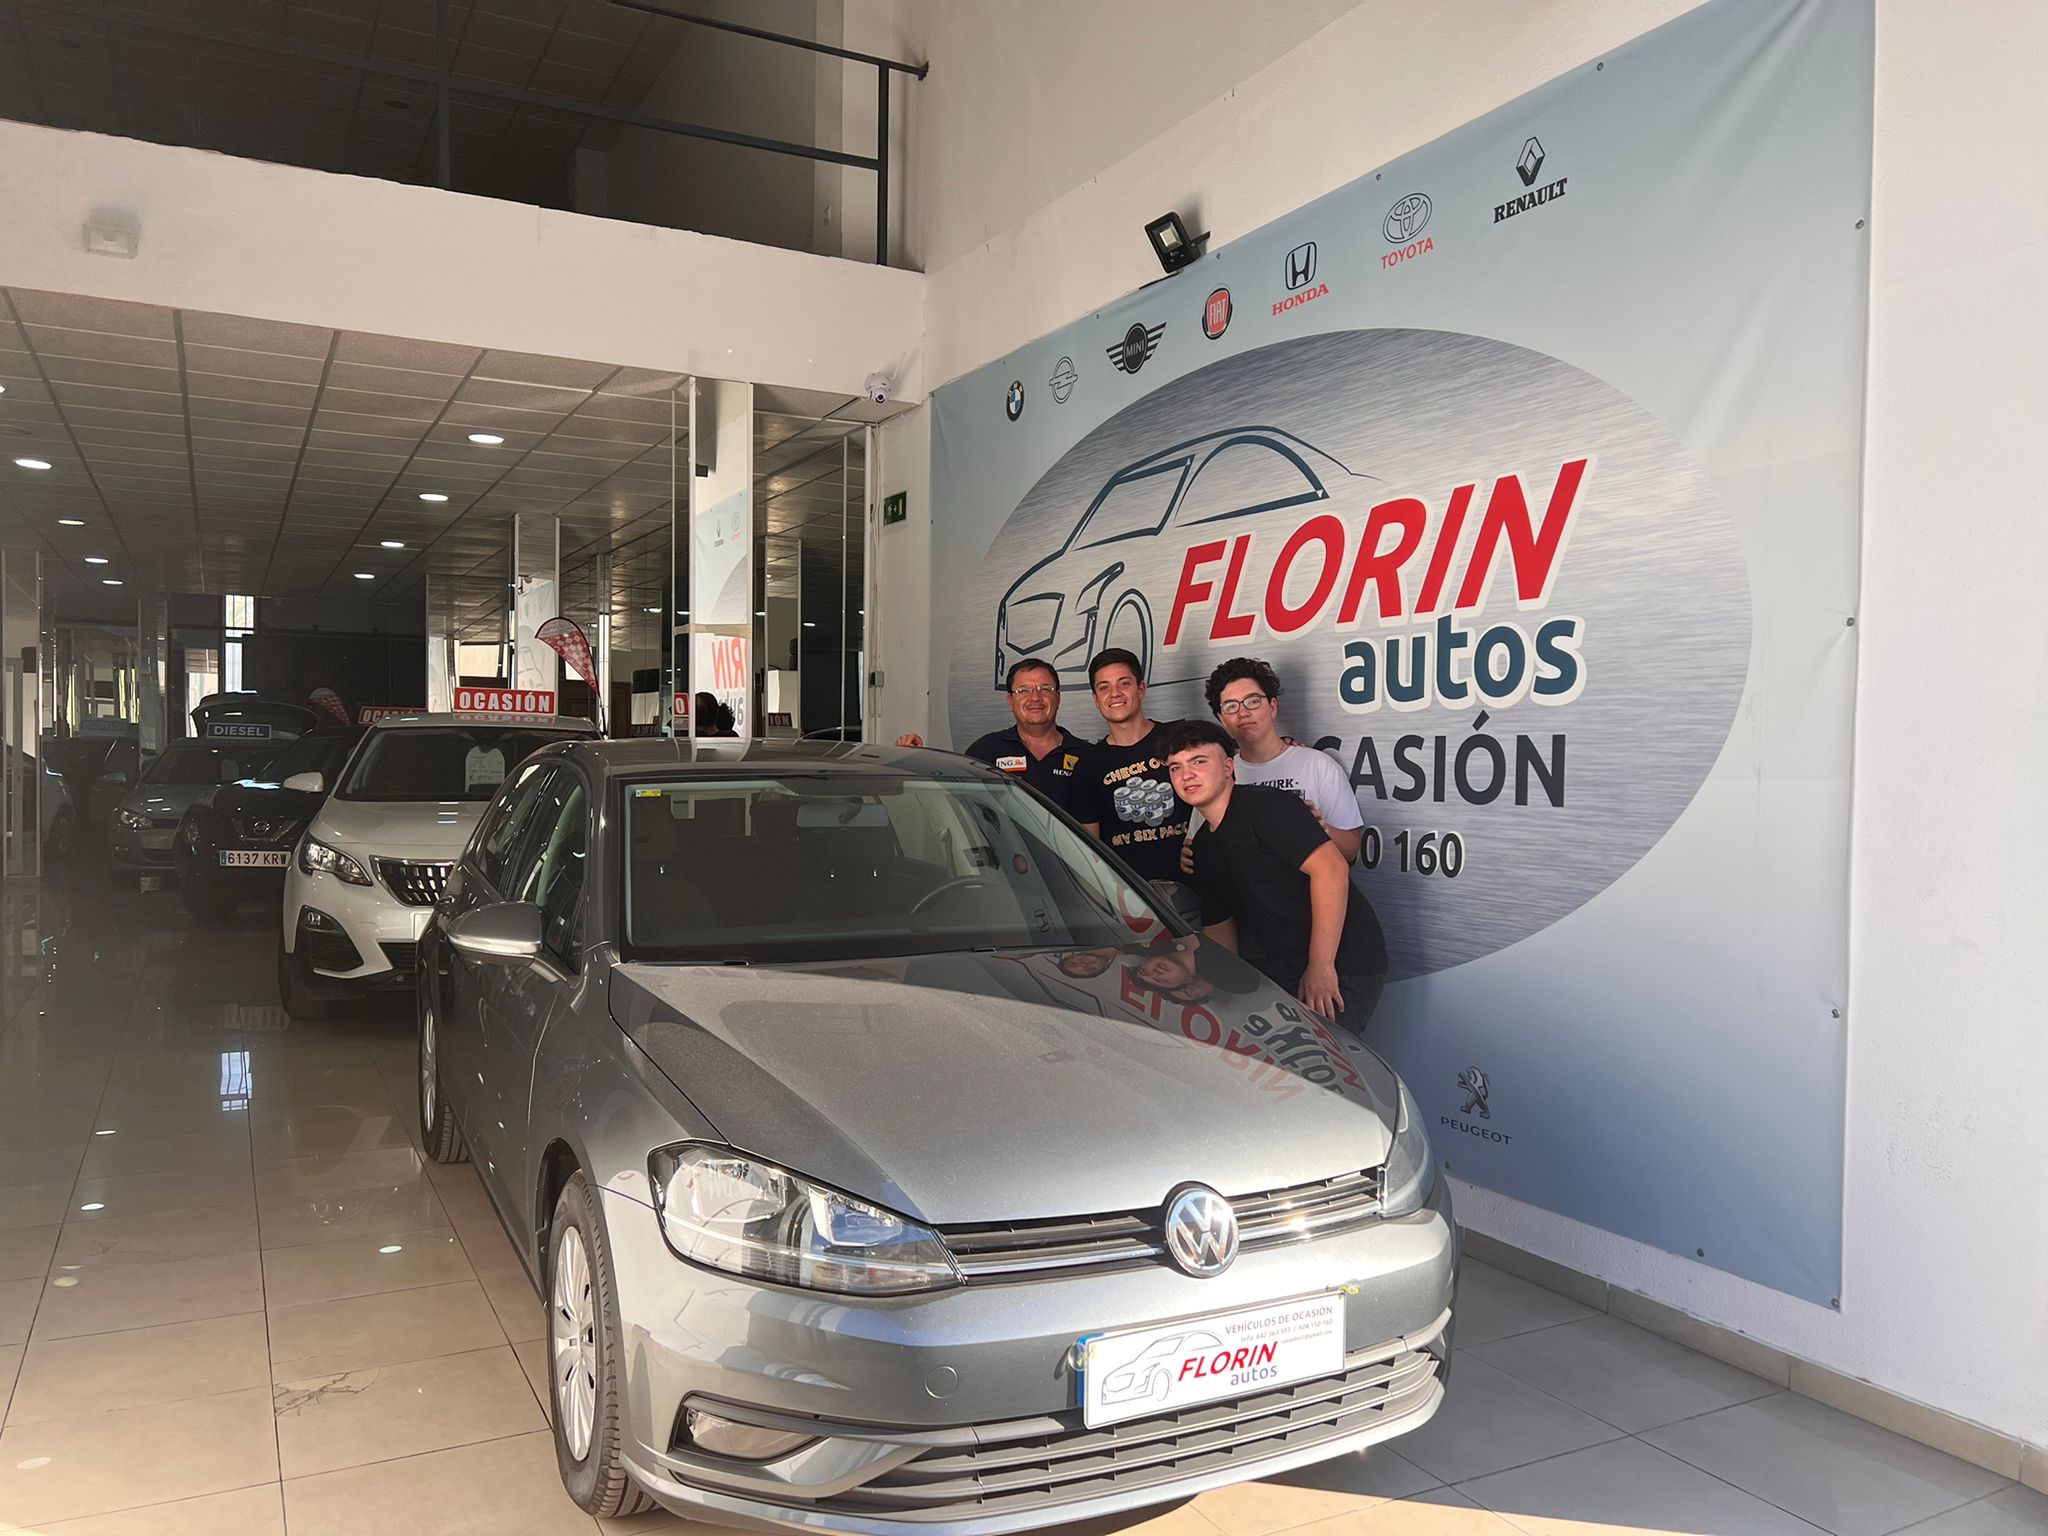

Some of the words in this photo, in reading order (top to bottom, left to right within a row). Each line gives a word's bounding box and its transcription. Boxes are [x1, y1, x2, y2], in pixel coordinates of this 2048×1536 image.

[1493, 177, 1568, 224] RENAULT
[1380, 237, 1434, 270] TOYOTA
[1209, 298, 1227, 328] FIAT
[1271, 283, 1329, 316] HONDA
[1125, 338, 1146, 357] MINI
[1162, 458, 1588, 646] FLORIN
[1338, 614, 1579, 705] autos
[459, 691, 551, 713] OCASIÓN
[213, 725, 265, 737] DIESEL
[1103, 761, 1148, 785] CHECK
[1112, 832, 1131, 847] MY
[1133, 828, 1158, 842] SIX
[1160, 822, 1189, 839] PACK
[227, 853, 259, 865] 6137
[263, 853, 287, 866] KRW
[1394, 830, 1465, 879] 160
[1440, 1116, 1512, 1145] PEUGEOT
[1225, 1316, 1276, 1335] VEHÍCULOS
[1278, 1314, 1290, 1324] DE
[1292, 1305, 1333, 1321] OCASIÓN
[1178, 1341, 1278, 1382] FLORIN
[1230, 1365, 1278, 1386] autos
